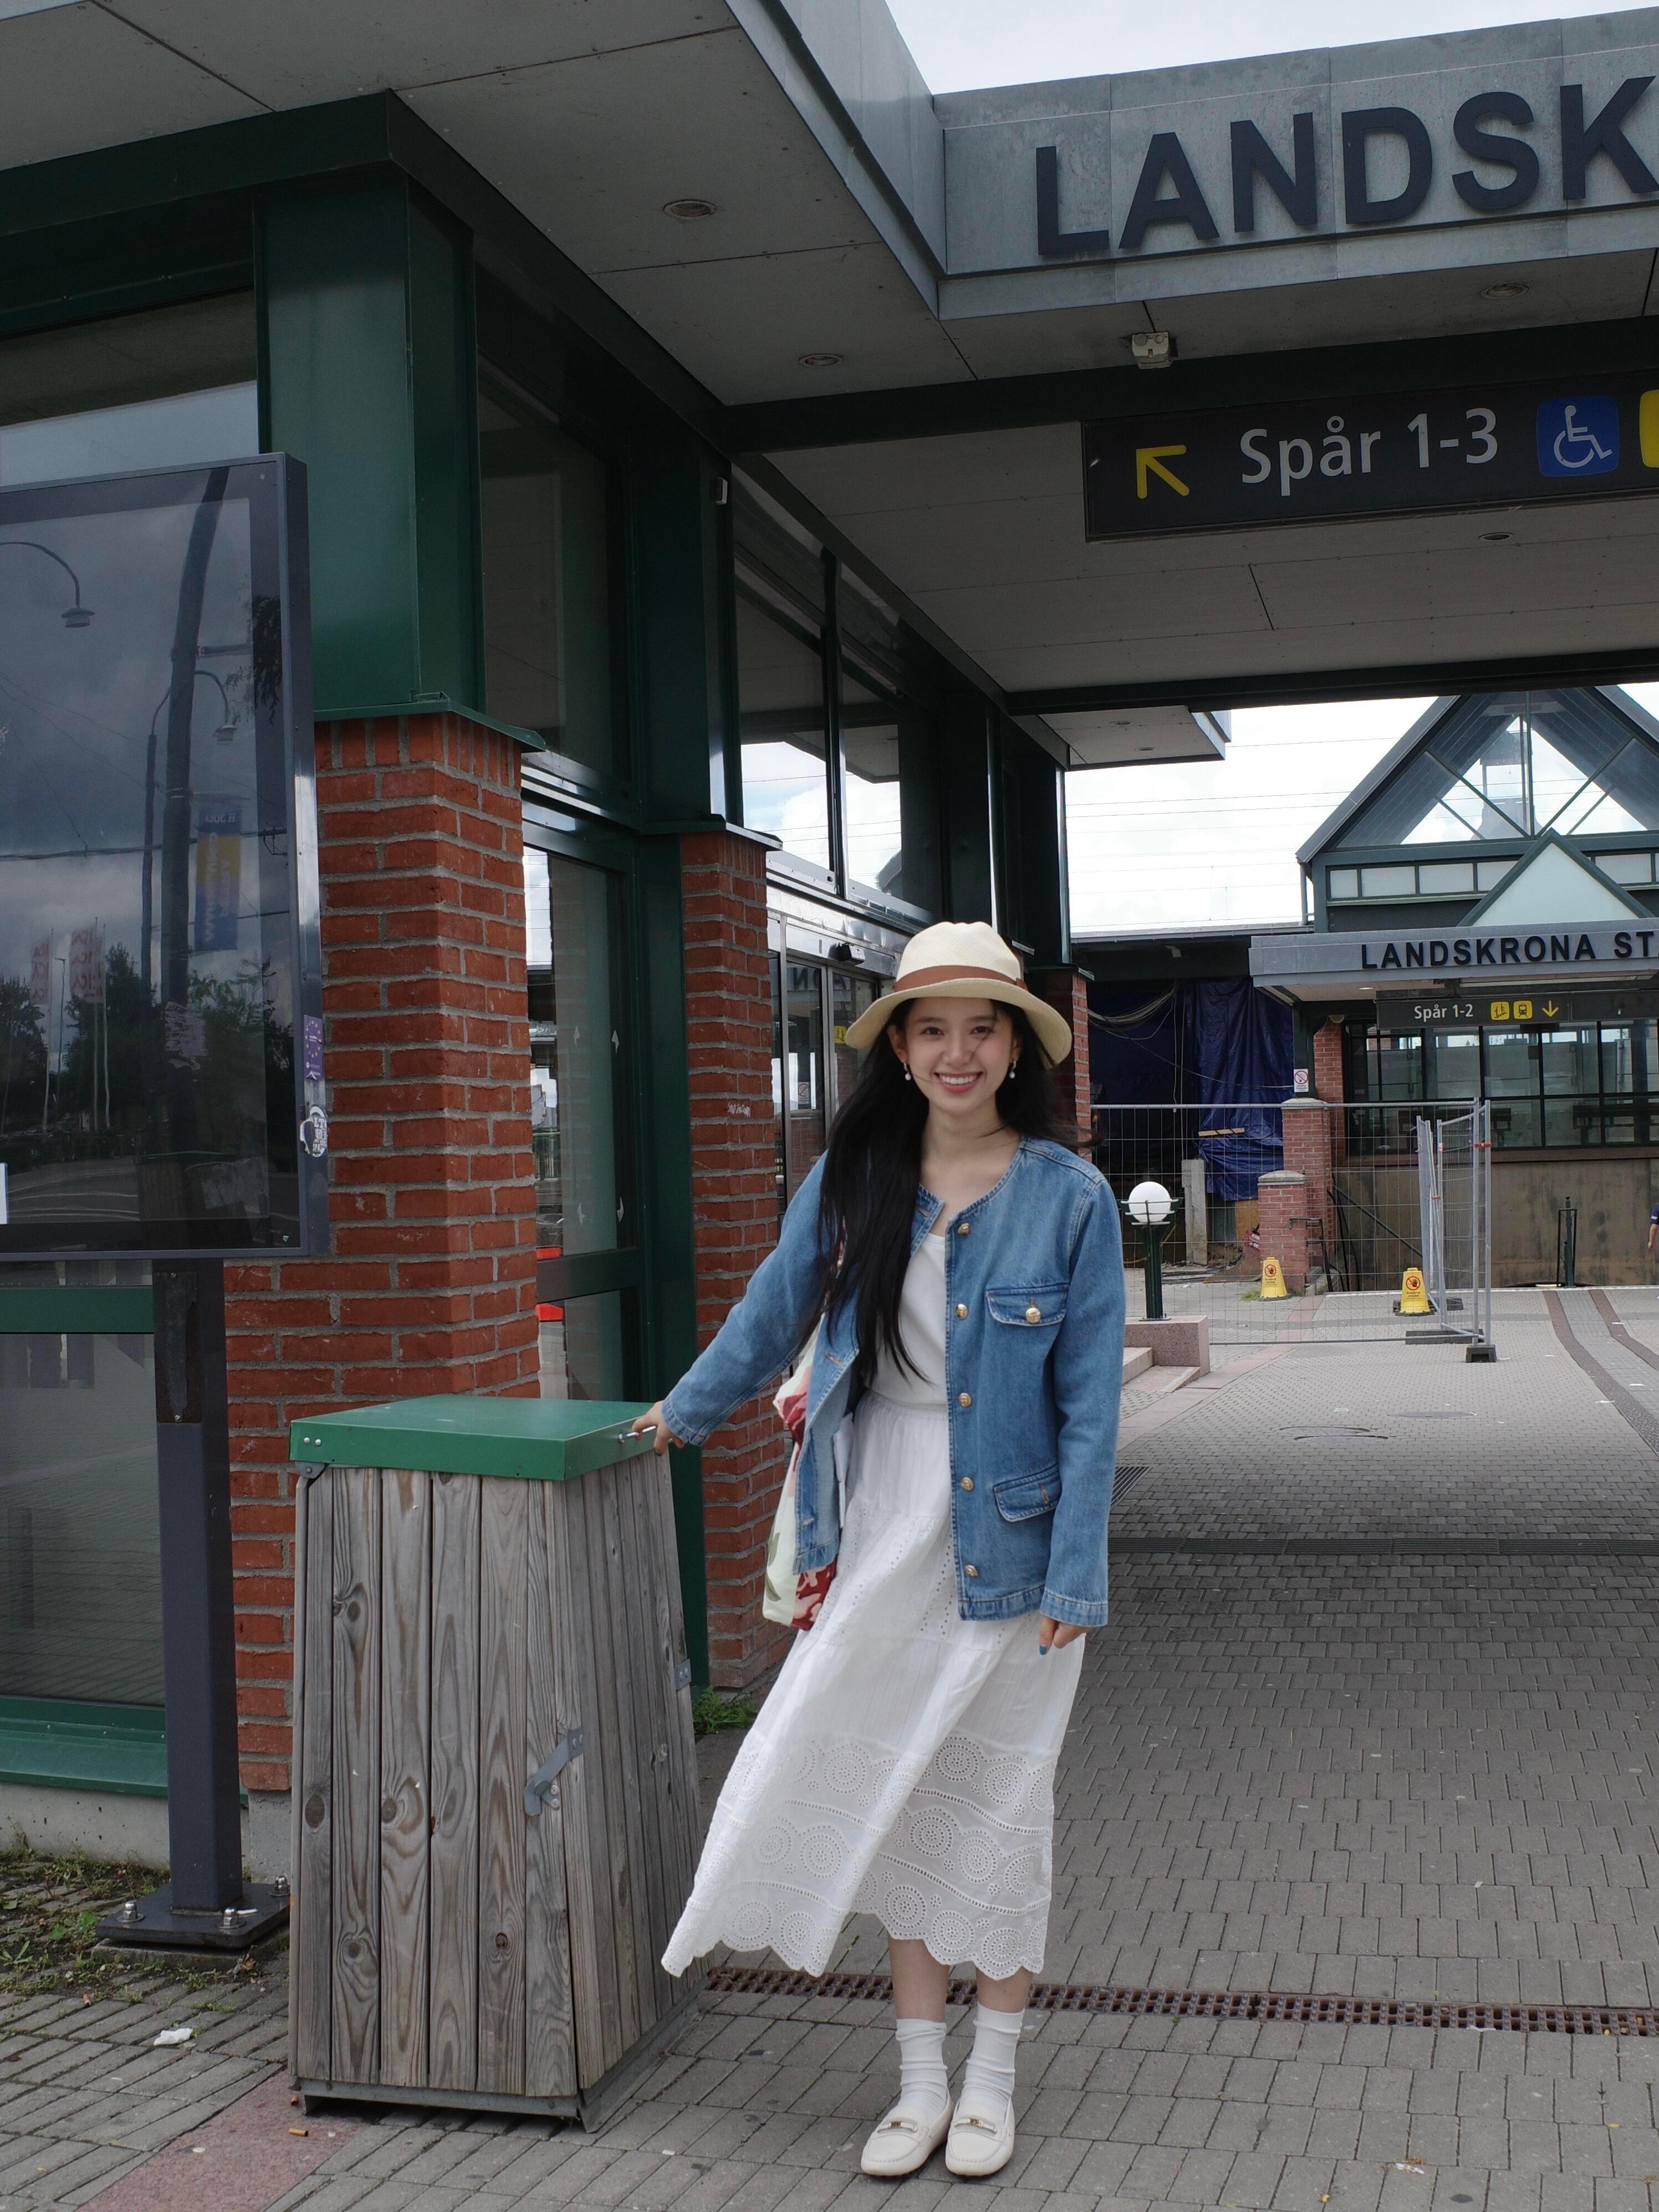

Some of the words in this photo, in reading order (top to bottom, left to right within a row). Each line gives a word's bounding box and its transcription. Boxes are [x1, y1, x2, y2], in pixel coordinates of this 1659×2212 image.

[1035, 75, 1659, 256] LANDSK
[1239, 415, 1382, 497] Spår
[1407, 407, 1498, 469] 1-3
[1361, 934, 1596, 969] LANDSKRONA
[1614, 931, 1659, 959] ST
[1414, 1004, 1447, 1023] Spår
[1452, 1004, 1474, 1018] 1-2
